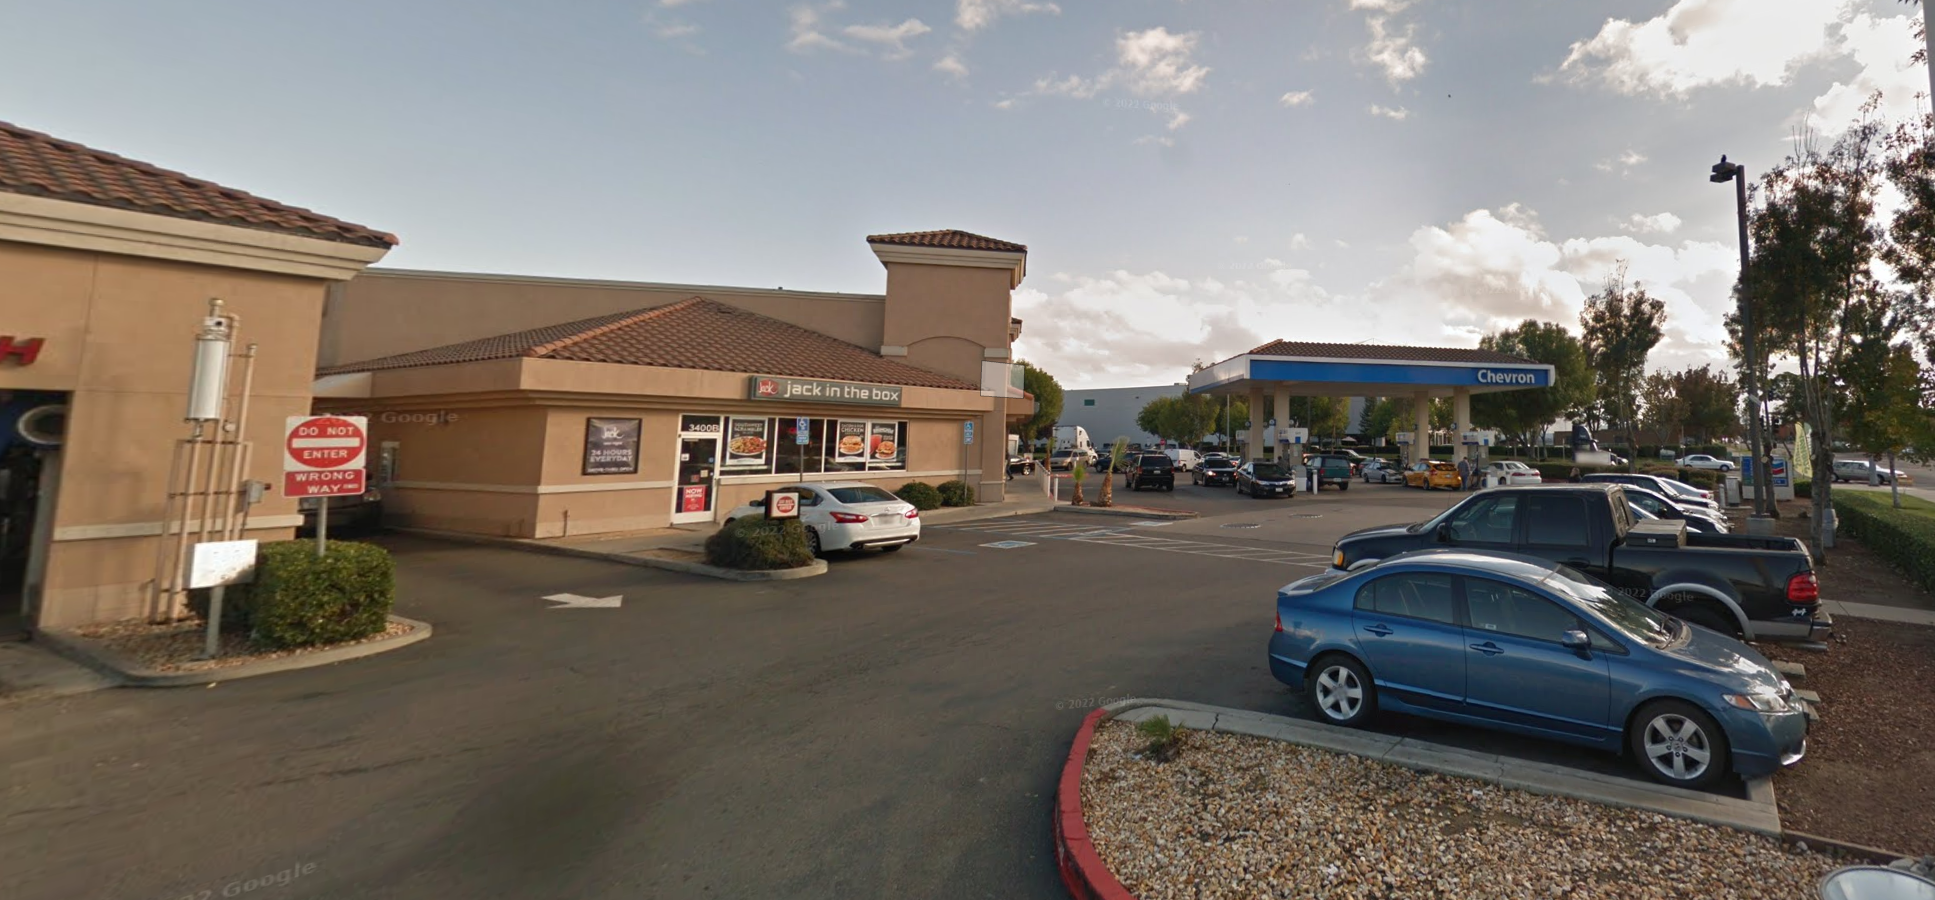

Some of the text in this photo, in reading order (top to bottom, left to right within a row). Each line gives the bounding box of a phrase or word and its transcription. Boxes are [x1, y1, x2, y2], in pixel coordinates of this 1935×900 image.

[1477, 369, 1535, 384] Chevron
[784, 381, 900, 401] jack in the box
[299, 427, 354, 436] DO NOT
[688, 424, 720, 432] 3400B
[302, 449, 348, 459] ENTER
[590, 455, 633, 463] EVERYDAY
[295, 471, 355, 482] WRONG
[307, 484, 341, 494] WAY
